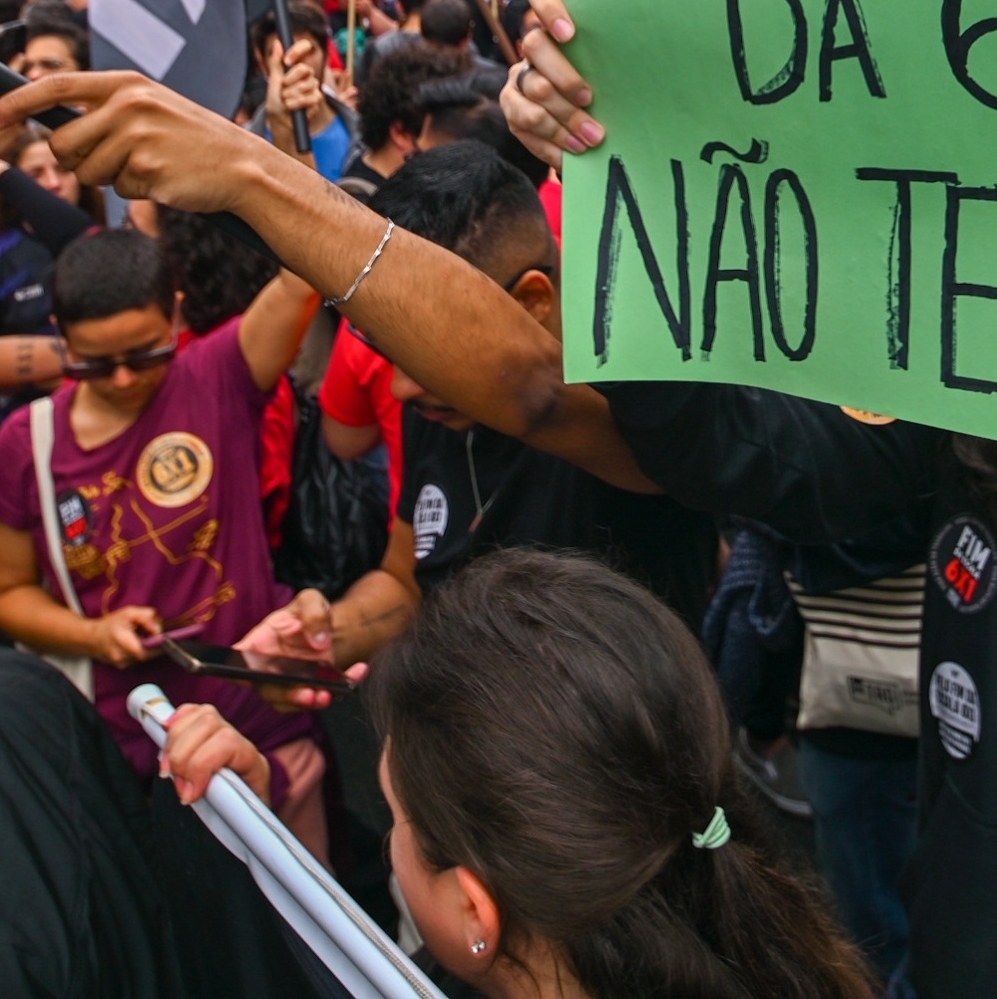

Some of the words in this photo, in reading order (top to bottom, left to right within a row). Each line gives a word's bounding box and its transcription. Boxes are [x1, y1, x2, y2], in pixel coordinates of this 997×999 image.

[594, 138, 819, 364] NÃO
[956, 525, 992, 570] FIM
[944, 558, 979, 602] 6X1
